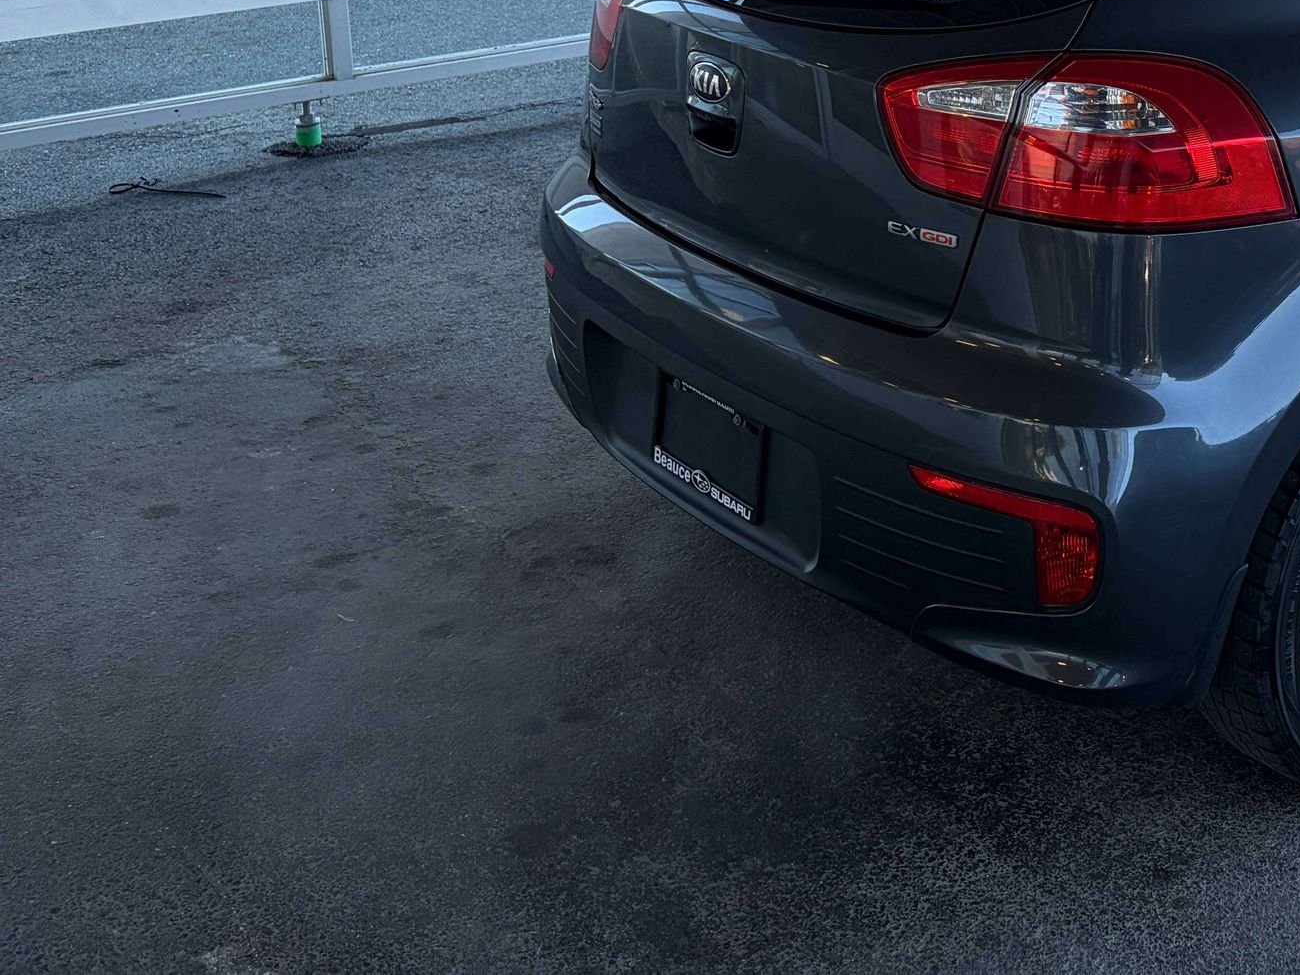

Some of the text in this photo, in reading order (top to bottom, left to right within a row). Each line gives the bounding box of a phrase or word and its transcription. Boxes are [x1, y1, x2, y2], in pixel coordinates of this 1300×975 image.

[692, 66, 721, 98] KIA
[887, 220, 954, 247] EX GDI
[654, 446, 751, 521] Beauce SUBARU
